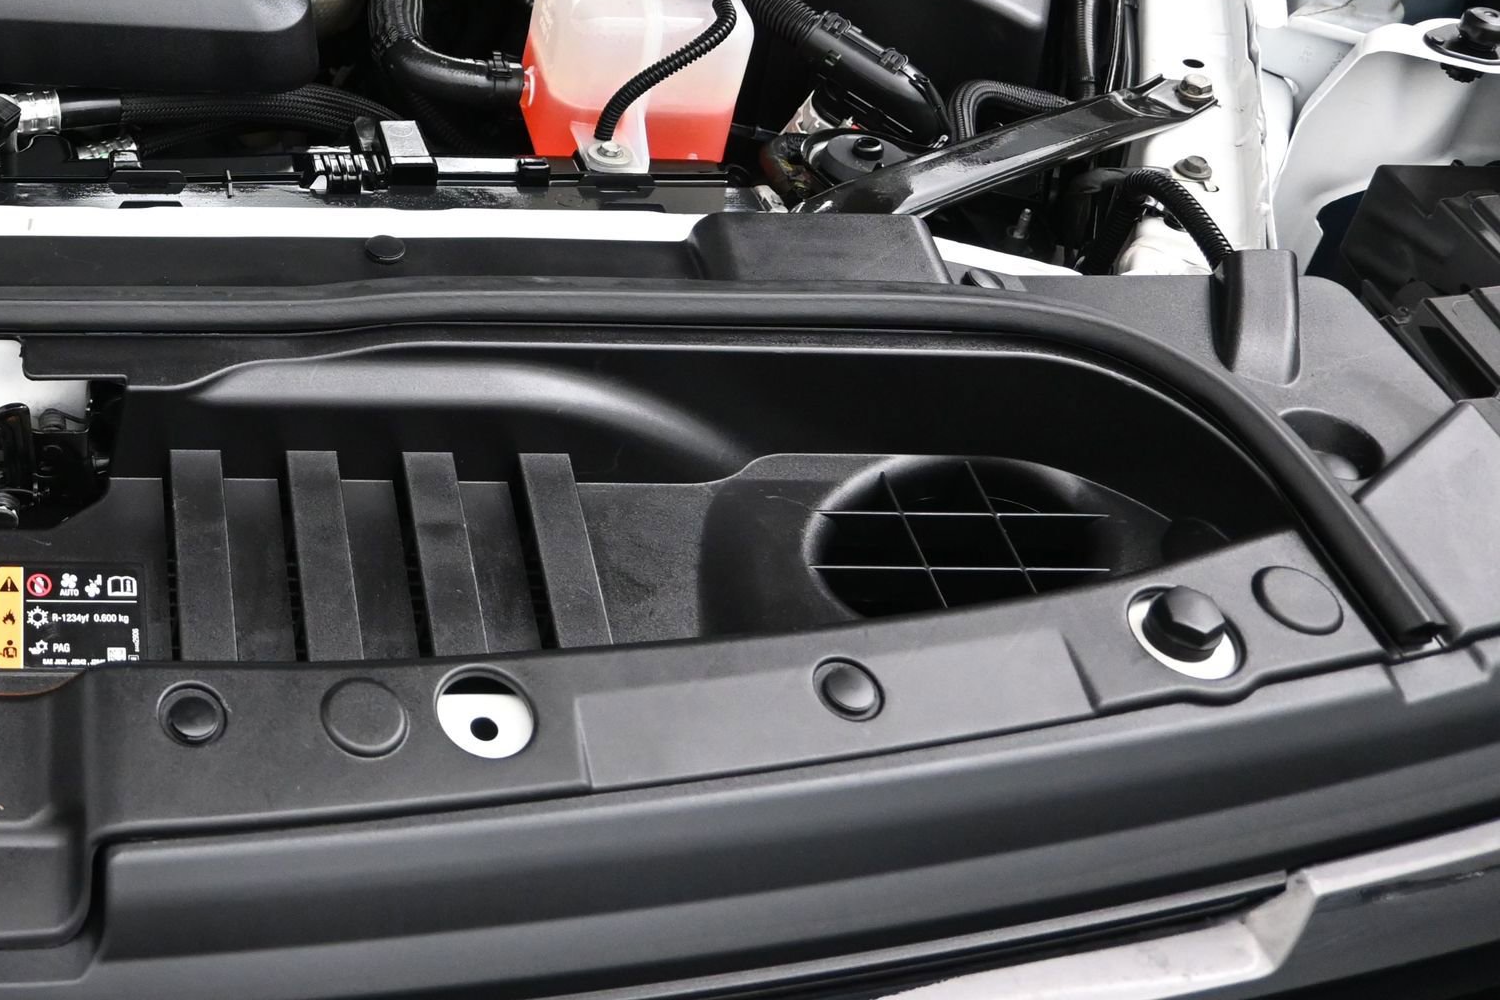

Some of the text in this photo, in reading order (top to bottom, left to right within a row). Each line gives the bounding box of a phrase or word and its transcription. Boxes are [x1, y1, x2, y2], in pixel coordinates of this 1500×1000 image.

[60, 589, 79, 597] AUTO
[52, 613, 90, 624] R-1234yf
[119, 614, 129, 624] kg
[52, 642, 71, 653] PAG
